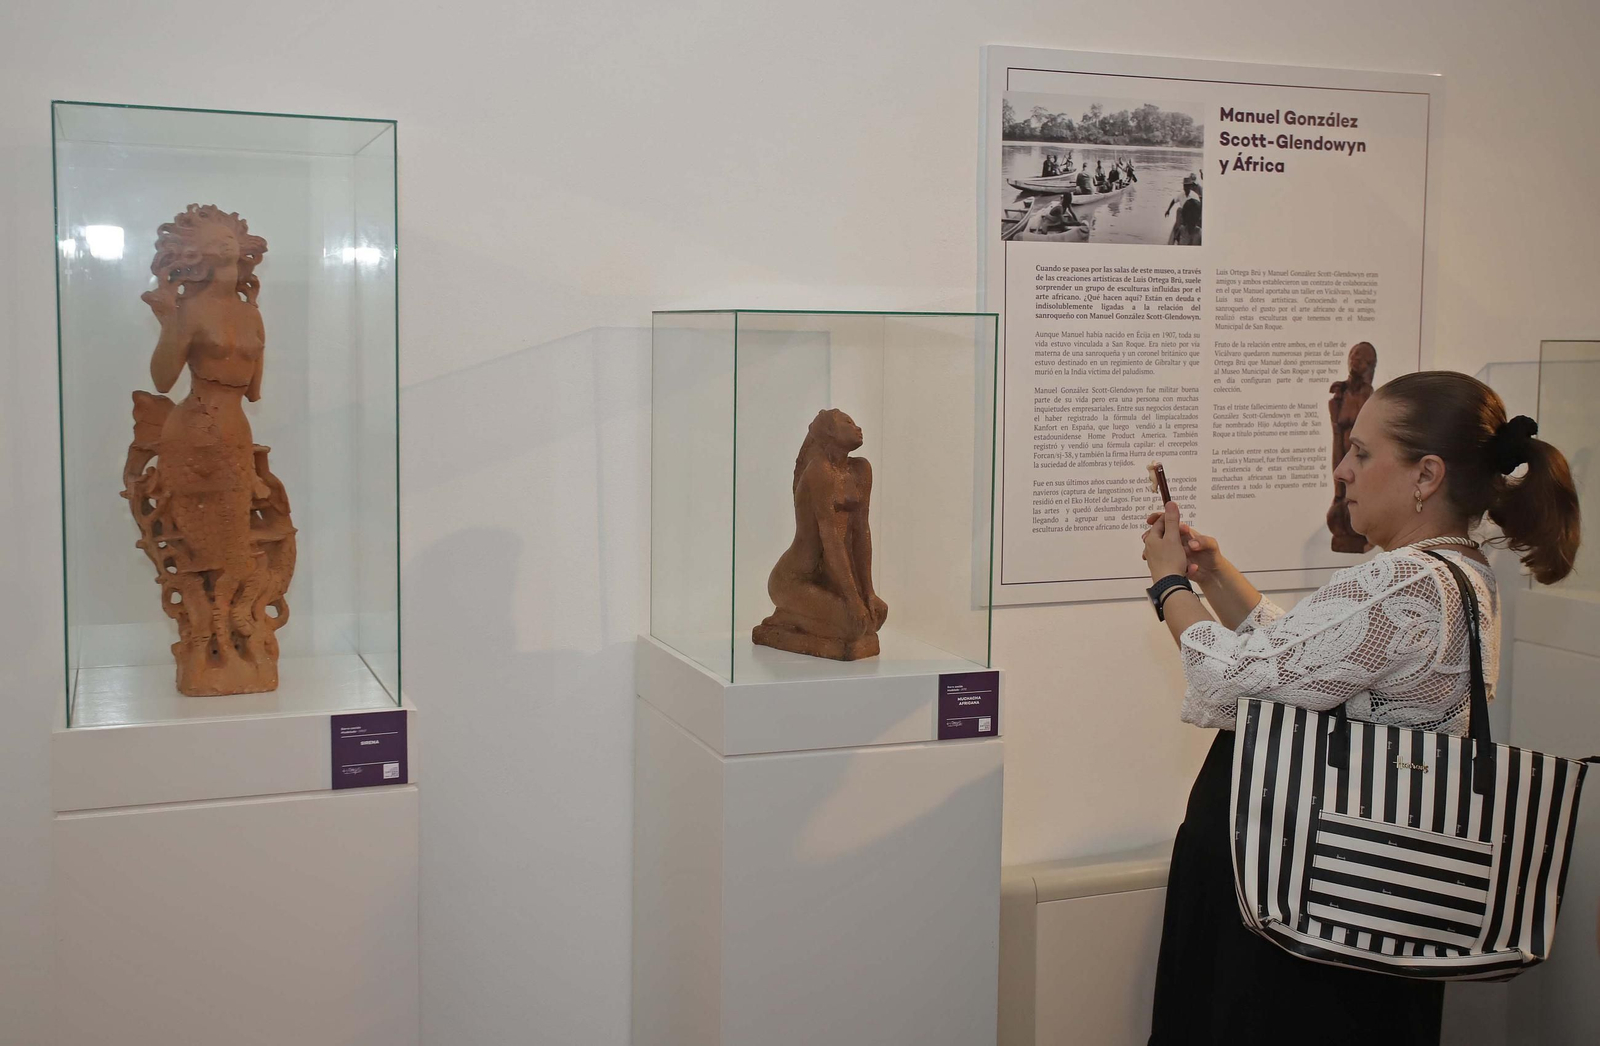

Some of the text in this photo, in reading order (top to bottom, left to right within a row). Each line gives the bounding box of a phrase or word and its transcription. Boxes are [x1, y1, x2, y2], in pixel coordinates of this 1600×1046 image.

[1220, 107, 1358, 128] Manuel González
[1220, 132, 1366, 156] Scott-Glendowyn
[1219, 152, 1284, 175] y África
[1170, 276, 1184, 284] Brú,
[1035, 284, 1072, 292] sorprender
[1084, 294, 1100, 302] ¿Qué
[1125, 294, 1144, 302] aquí?
[1101, 303, 1124, 311] ligadas
[1146, 313, 1201, 321] Scott-Glendowyn.
[1136, 330, 1151, 339] Écija
[1092, 386, 1143, 394] Scott-Glendowyn
[1034, 405, 1070, 413] inquietudes
[1072, 405, 1115, 413] empresariales.
[1112, 423, 1129, 431] luego
